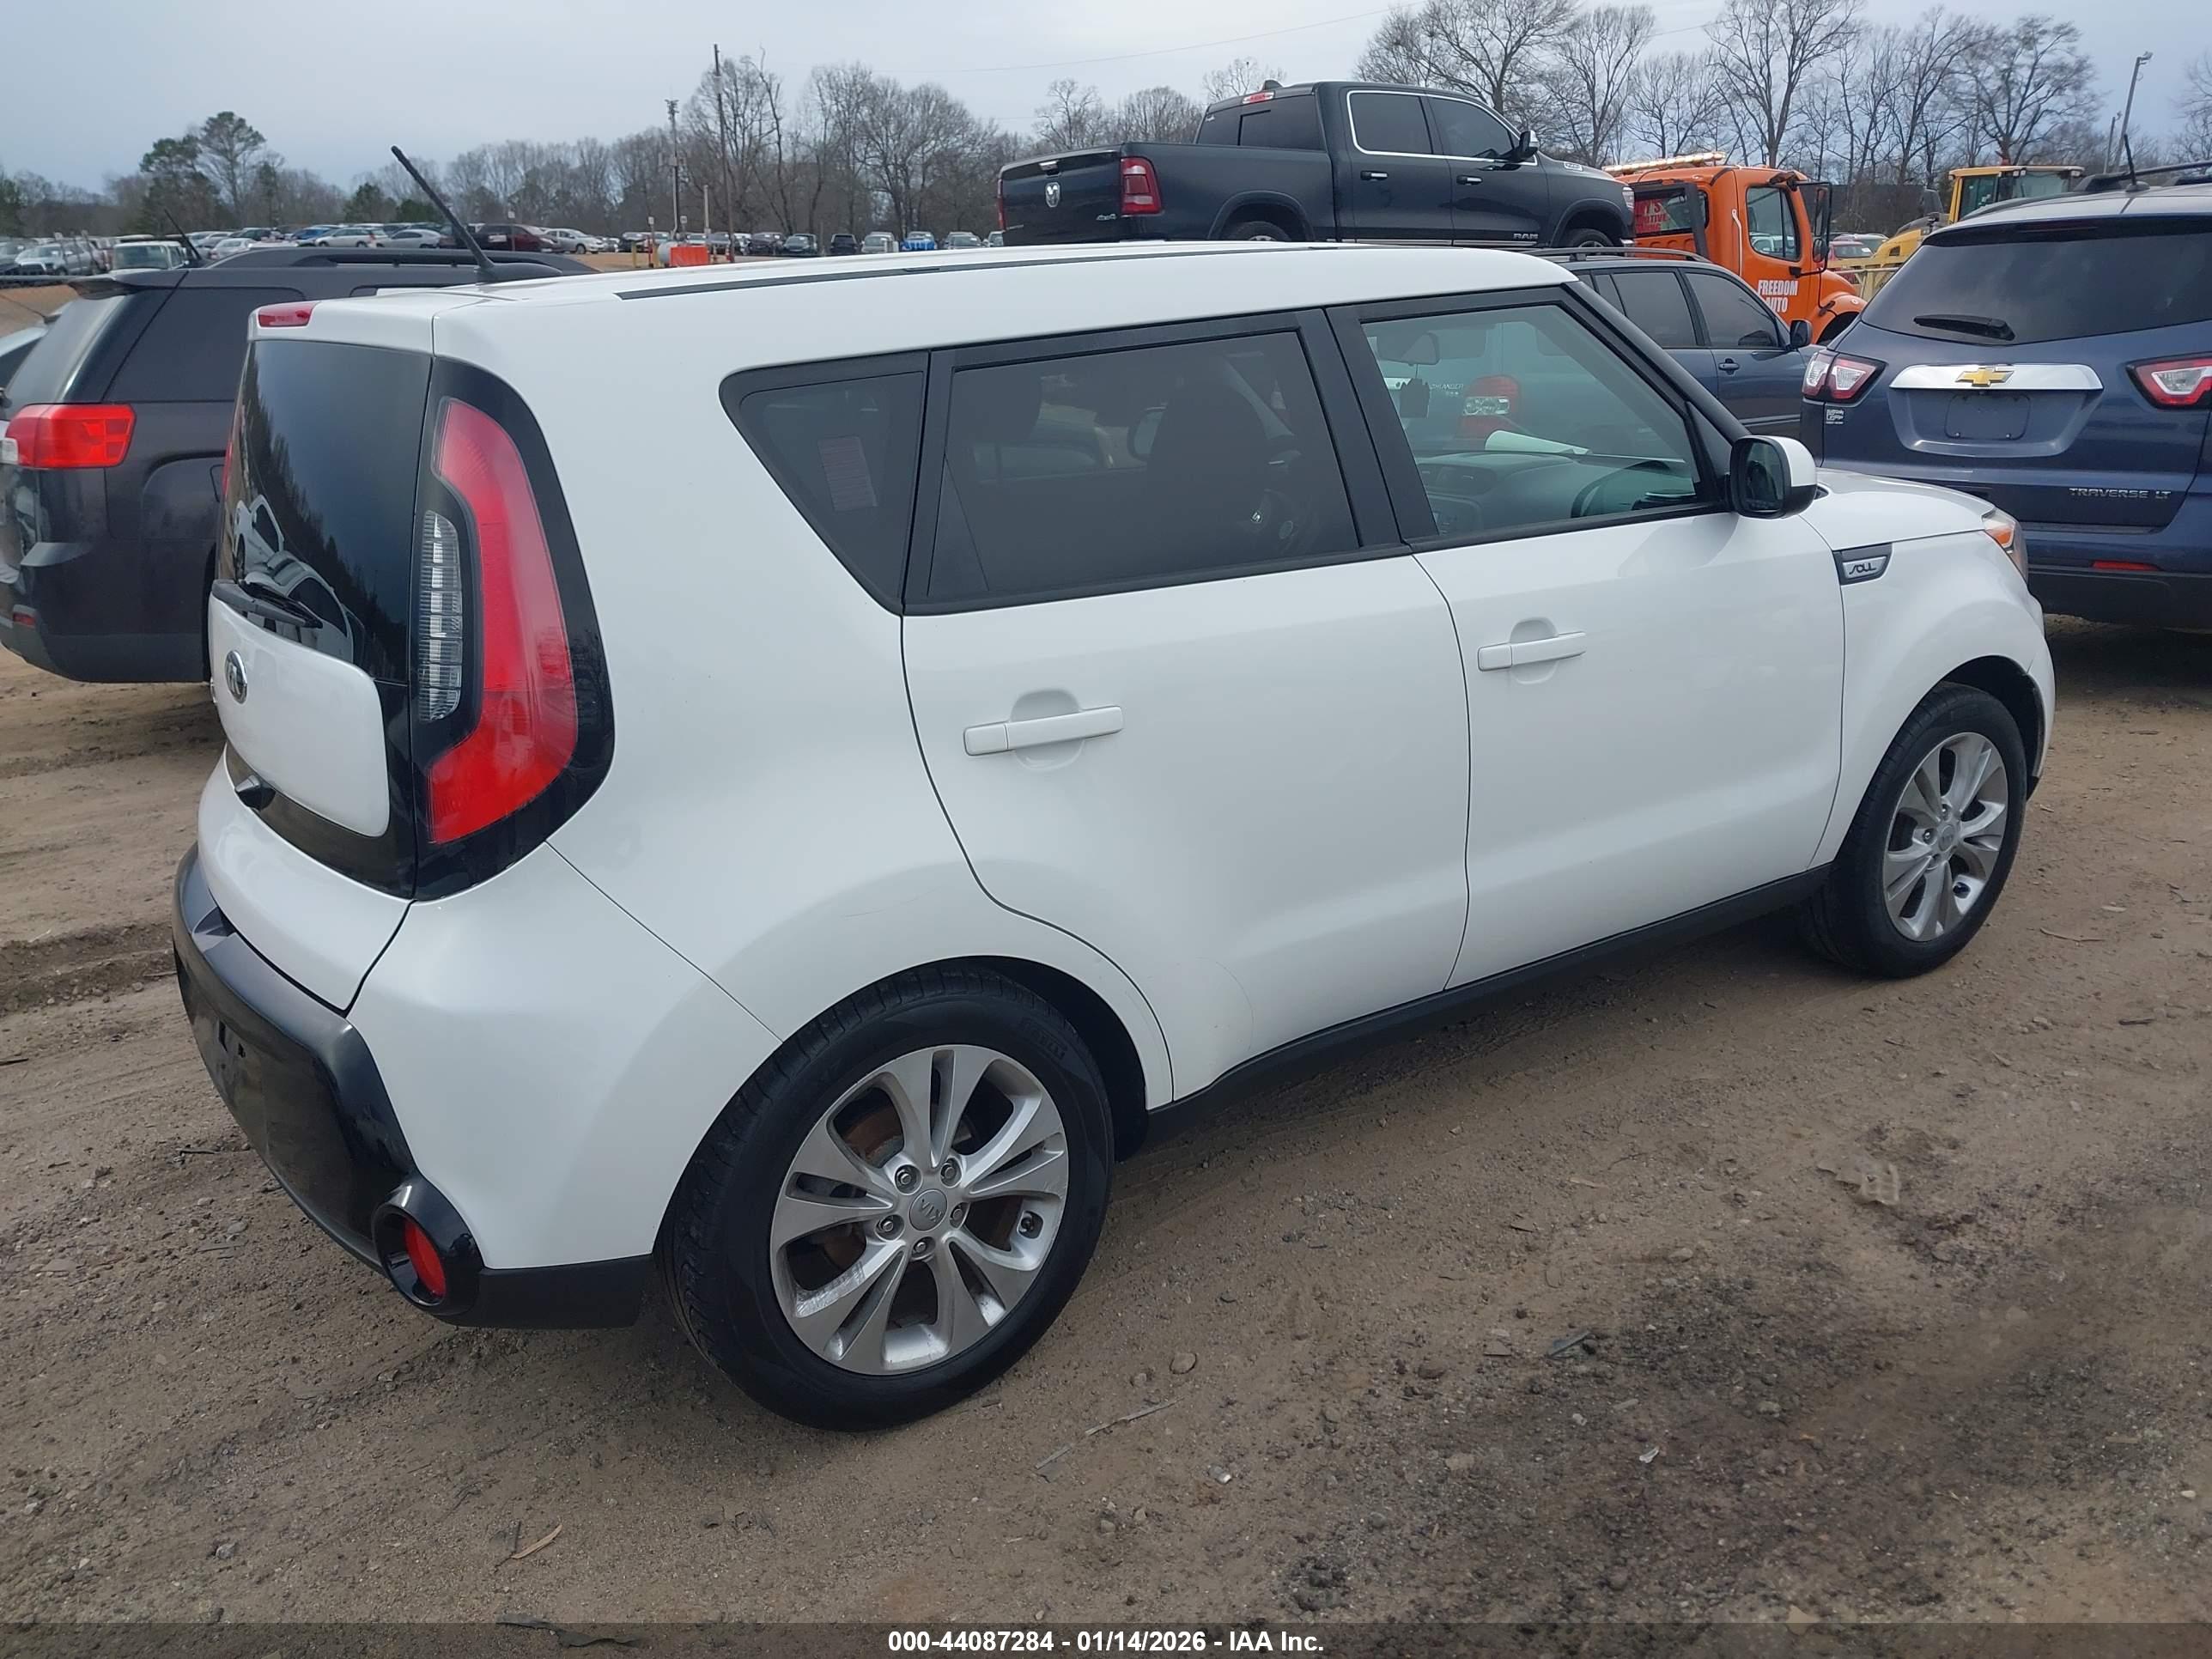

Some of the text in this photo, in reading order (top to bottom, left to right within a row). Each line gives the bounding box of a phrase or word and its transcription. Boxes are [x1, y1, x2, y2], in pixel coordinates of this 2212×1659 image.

[1757, 279, 1799, 296] FREEDOM
[2069, 488, 2172, 499] TRAVERSE LT
